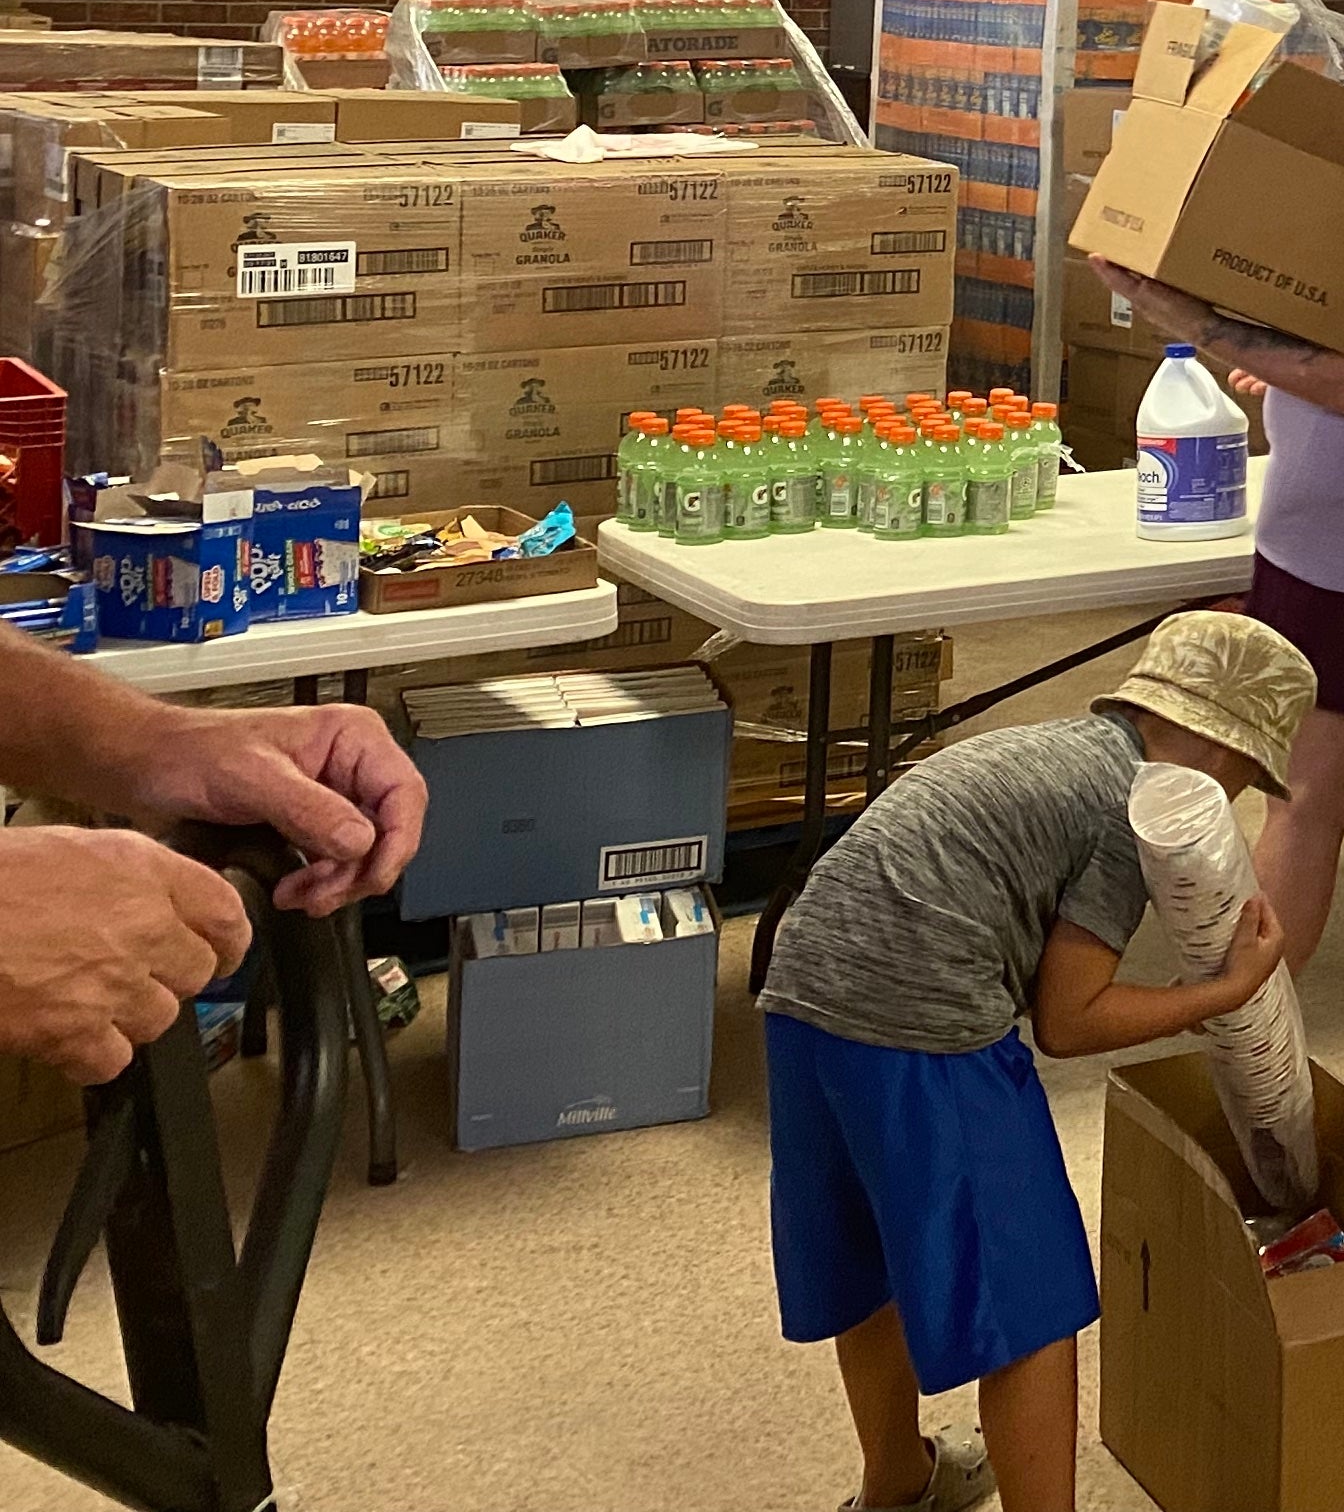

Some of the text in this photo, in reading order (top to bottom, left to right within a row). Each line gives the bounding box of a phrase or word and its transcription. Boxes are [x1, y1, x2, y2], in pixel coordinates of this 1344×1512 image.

[648, 36, 738, 54] ATORADE
[669, 180, 718, 201] 57122
[907, 174, 952, 194] 57122
[400, 185, 454, 207] 57122
[772, 219, 813, 232] QUAKER
[520, 229, 566, 244] QUAKER
[516, 252, 571, 266] GRANOLA
[1212, 248, 1273, 284] PRODUCT
[1275, 273, 1292, 292] OF
[898, 333, 943, 353] 57122
[659, 348, 709, 370] 57122
[389, 363, 444, 388] 57122
[763, 384, 805, 396] QUAKER
[509, 403, 556, 417] QUAKER
[220, 424, 273, 439] QUAKER
[506, 426, 561, 439] GRANOLA
[225, 448, 278, 462] RANOLA
[556, 1107, 617, 1126] Millville
